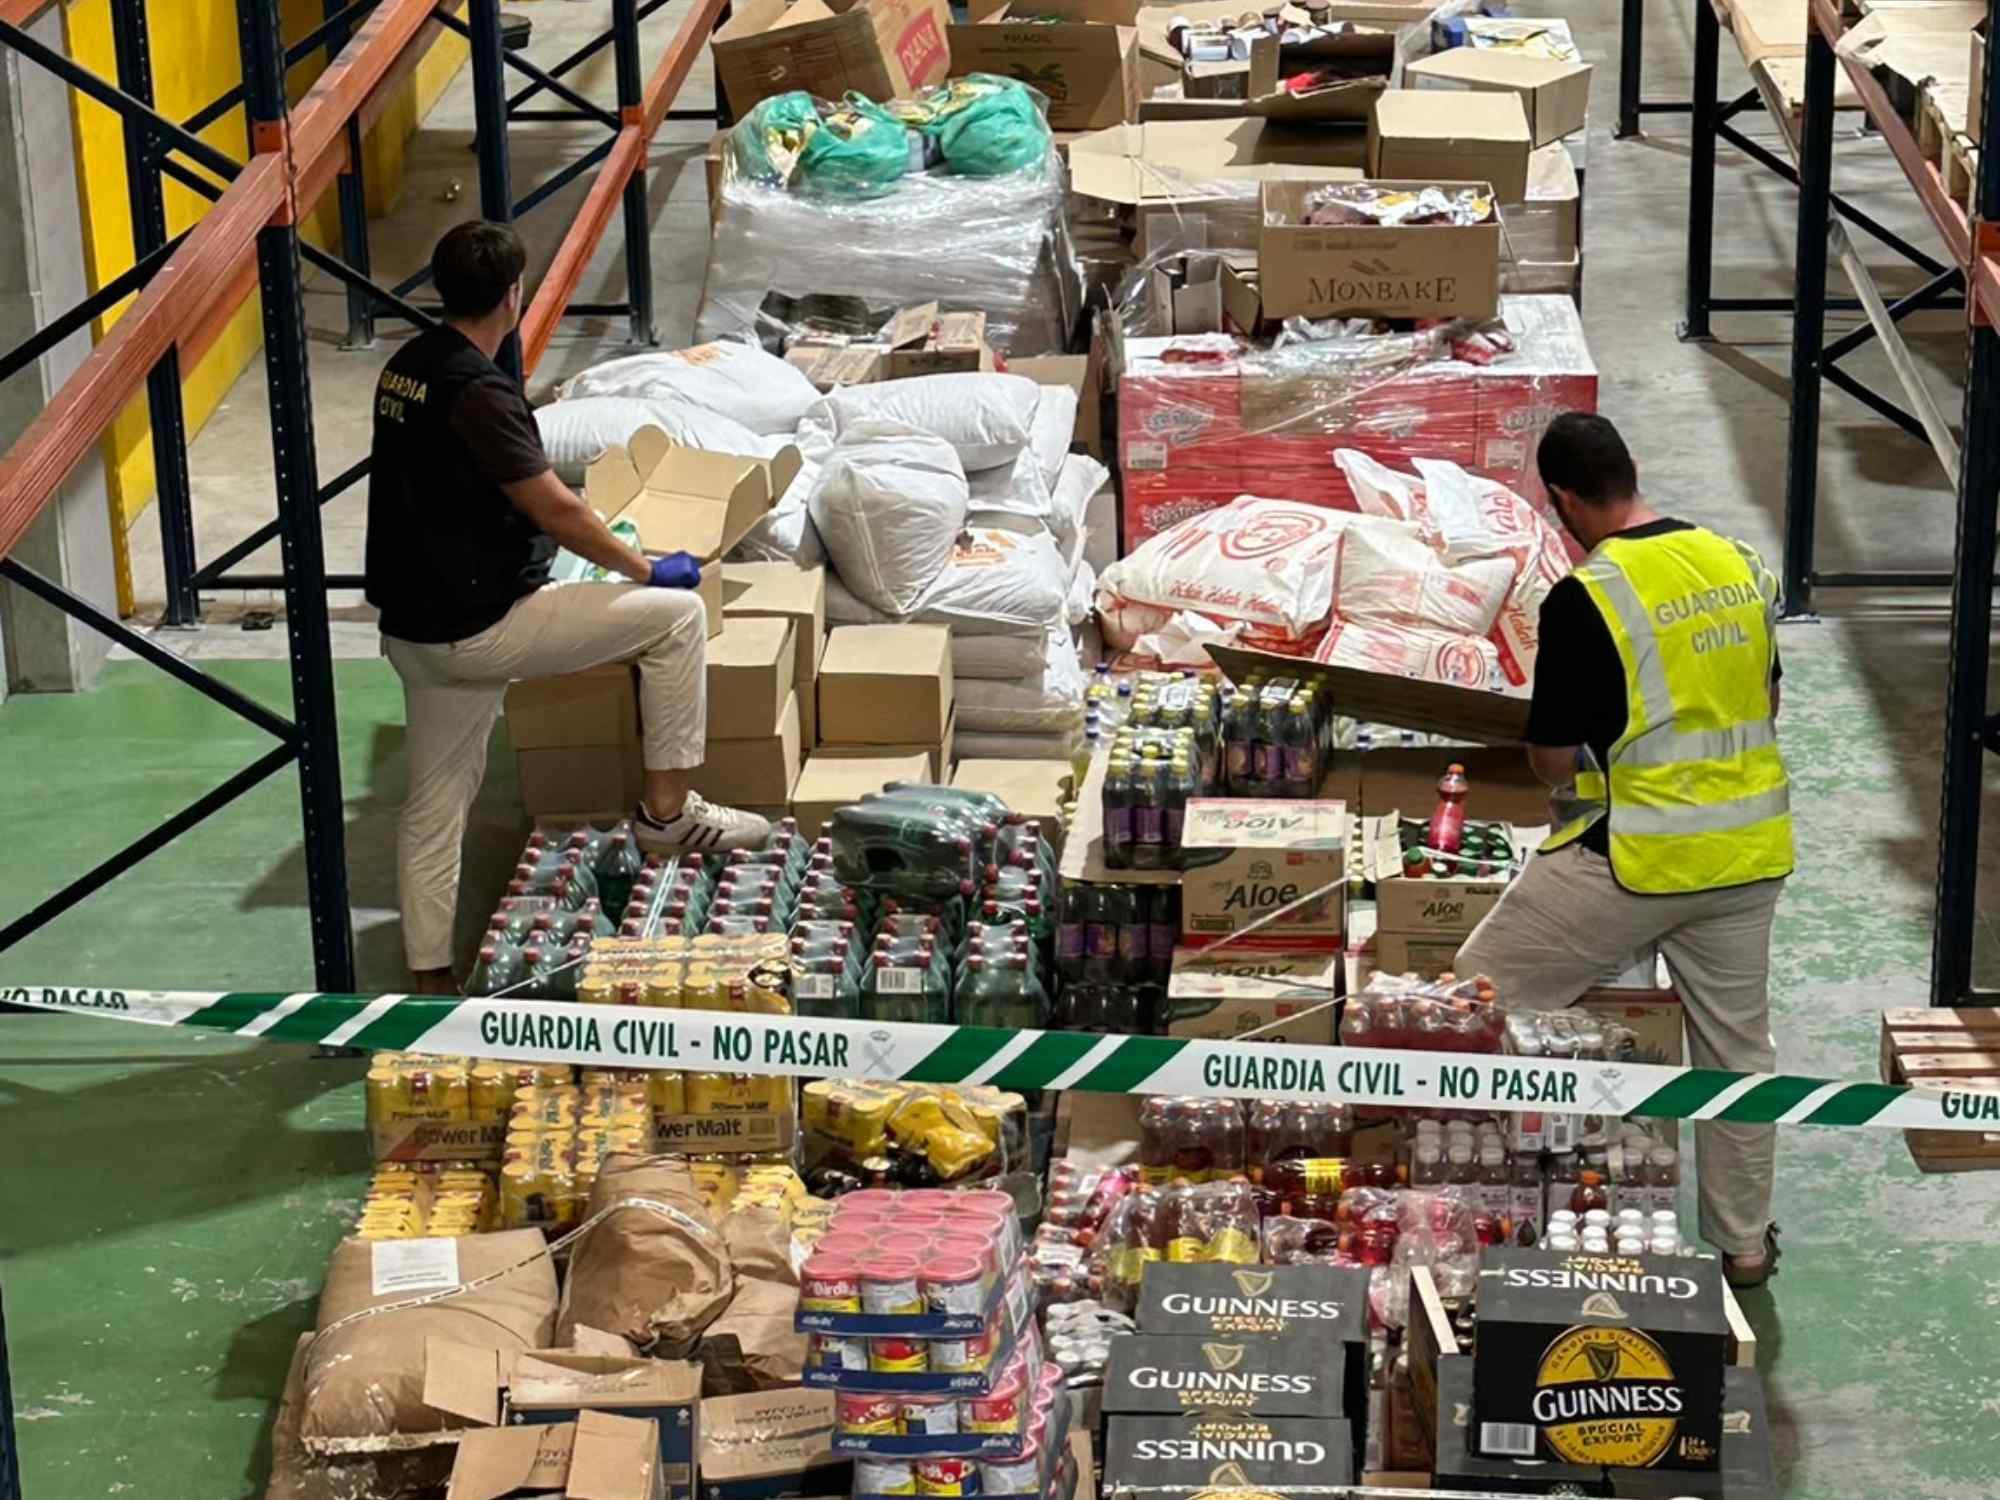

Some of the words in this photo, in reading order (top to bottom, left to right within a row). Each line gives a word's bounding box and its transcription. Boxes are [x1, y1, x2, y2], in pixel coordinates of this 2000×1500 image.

[1308, 276, 1457, 304] MONBAKE
[1655, 582, 1759, 625] GUARDIA
[1692, 622, 1748, 653] CIVIL
[1223, 883, 1299, 911] Aloe
[1421, 902, 1464, 917] Aloe
[480, 1010, 601, 1052] GUARDIA
[613, 1019, 680, 1057] CIVIL
[713, 1025, 752, 1062] NO
[764, 1028, 849, 1067] PASAR
[1203, 1053, 1326, 1092] GUARDIA
[1337, 1061, 1405, 1096] CIVIL
[1439, 1065, 1480, 1098] NO
[1490, 1067, 1578, 1103] PASAR
[1507, 1269, 1699, 1299] GUINNESS
[1161, 1293, 1340, 1320] GUINNESS
[1128, 1366, 1313, 1394] GUINNESS
[1532, 1386, 1683, 1422] GUINNESS
[1578, 1422, 1646, 1436] SPECIAL
[1582, 1432, 1643, 1447] EXPORT
[1136, 1439, 1326, 1465] GUINNESS
